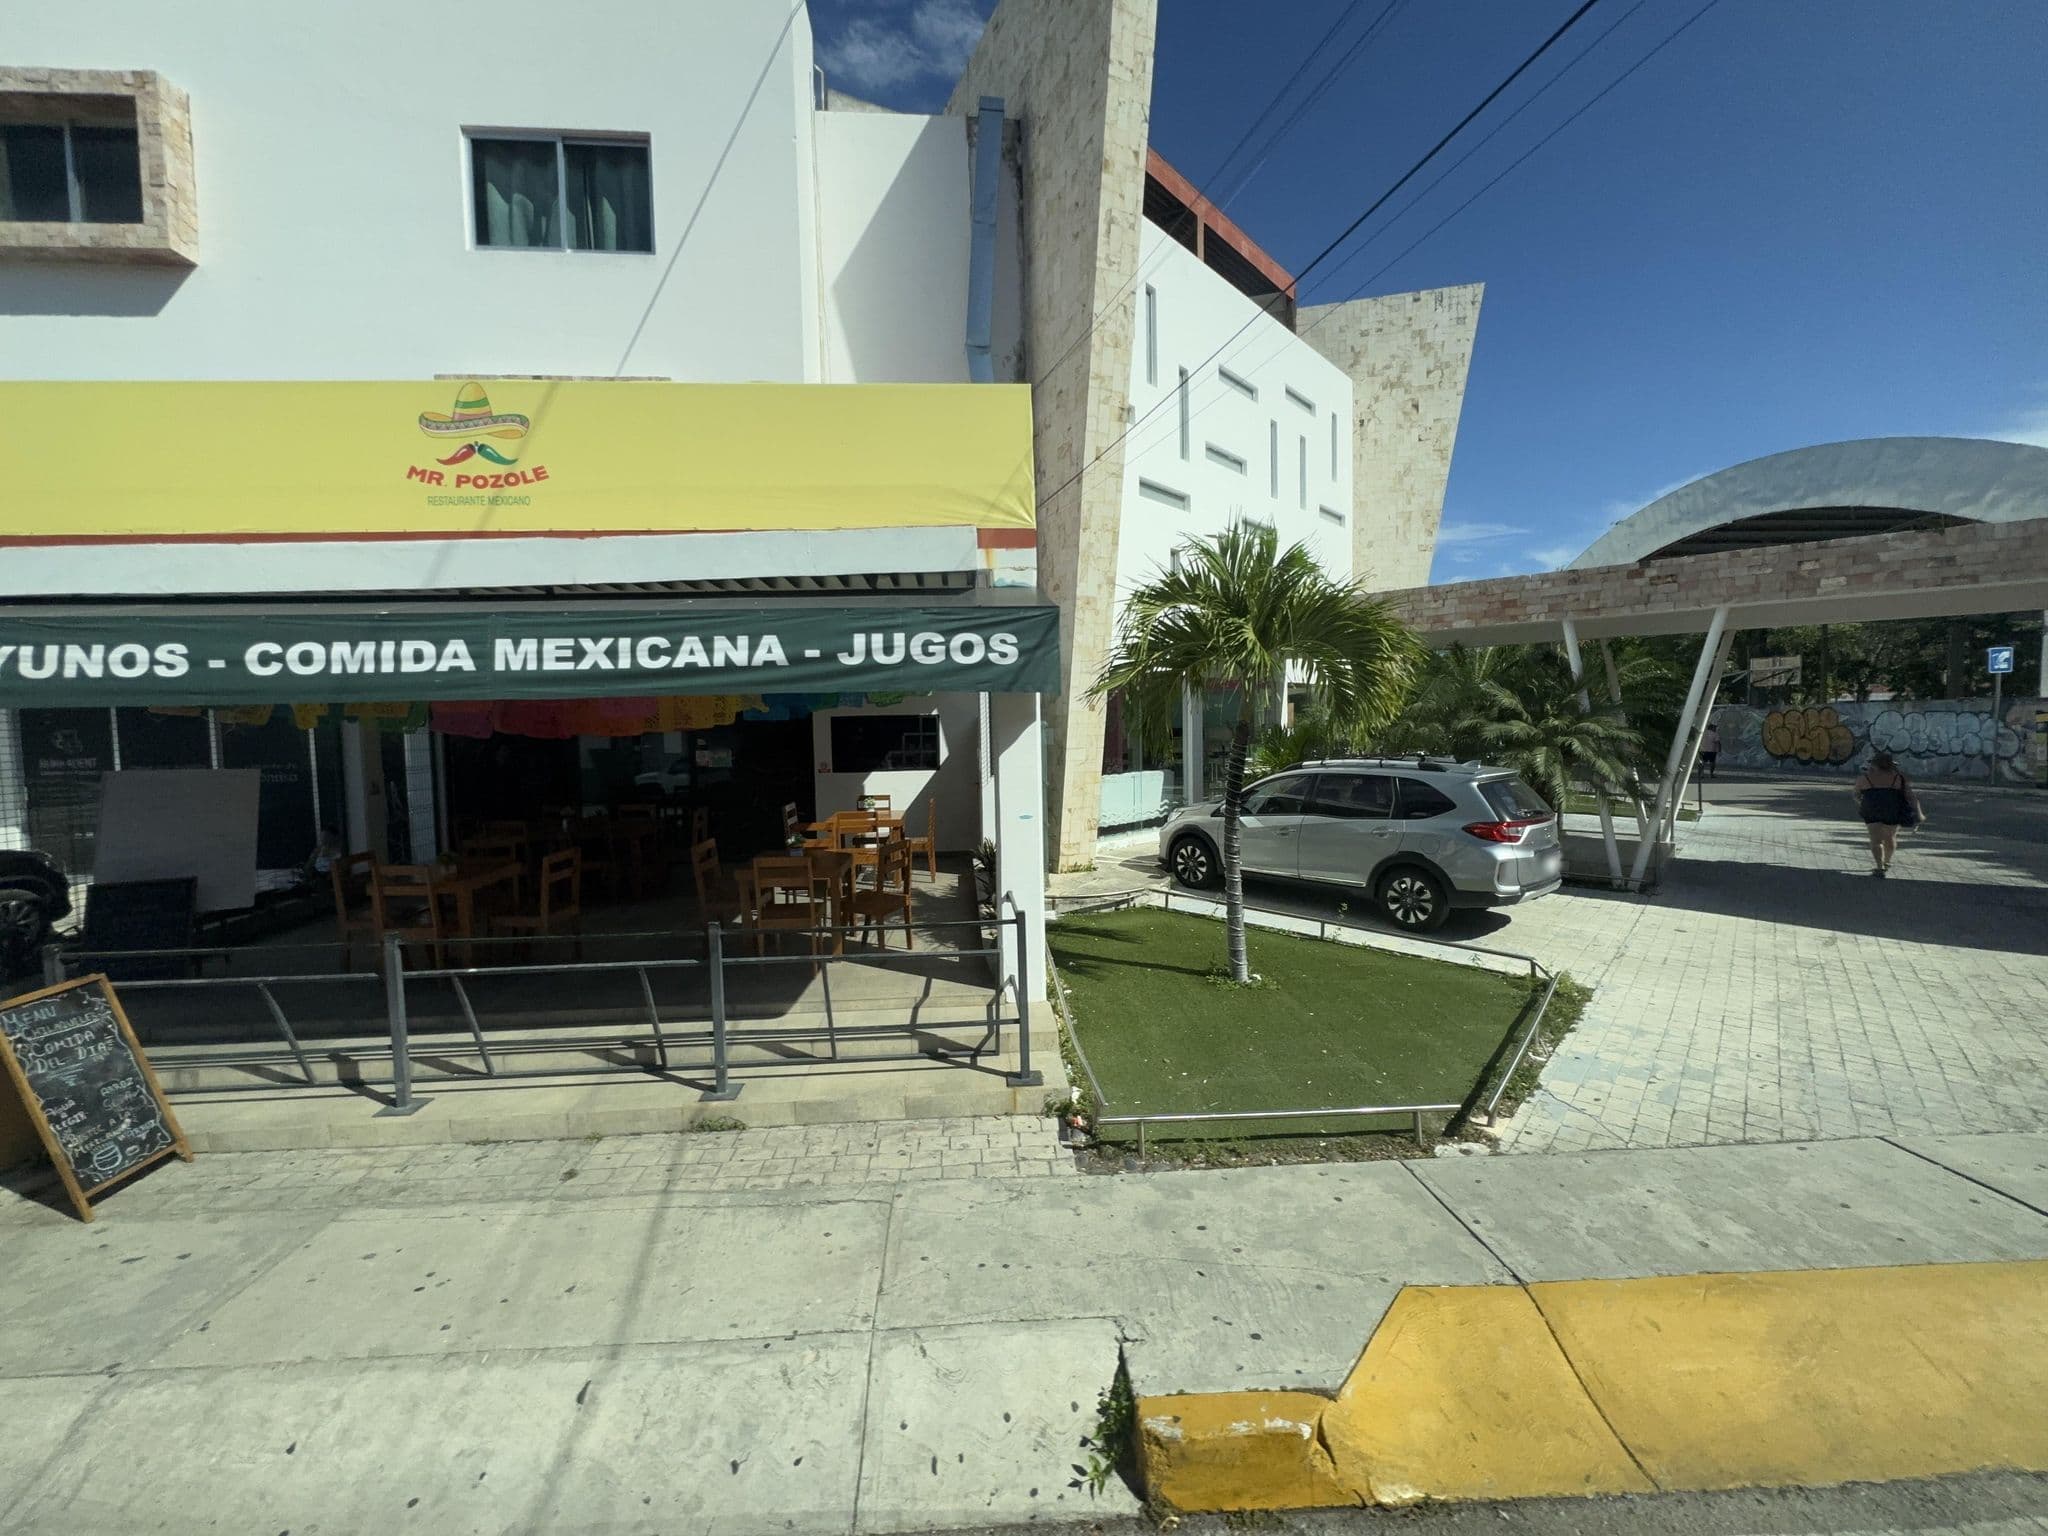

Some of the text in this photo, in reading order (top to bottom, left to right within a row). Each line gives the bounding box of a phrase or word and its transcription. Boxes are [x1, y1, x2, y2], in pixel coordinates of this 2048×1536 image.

[455, 465, 549, 489] POZOLE
[427, 496, 531, 506] RESTAURANTE MEXICANO
[208, 659, 226, 668] -
[244, 639, 476, 676] COMIDA
[494, 634, 788, 671] MEXICANA
[805, 649, 820, 658] -
[837, 632, 1019, 666] JUGOS
[31, 1030, 96, 1057] COMIDA
[34, 1041, 107, 1074] DEL DIA
